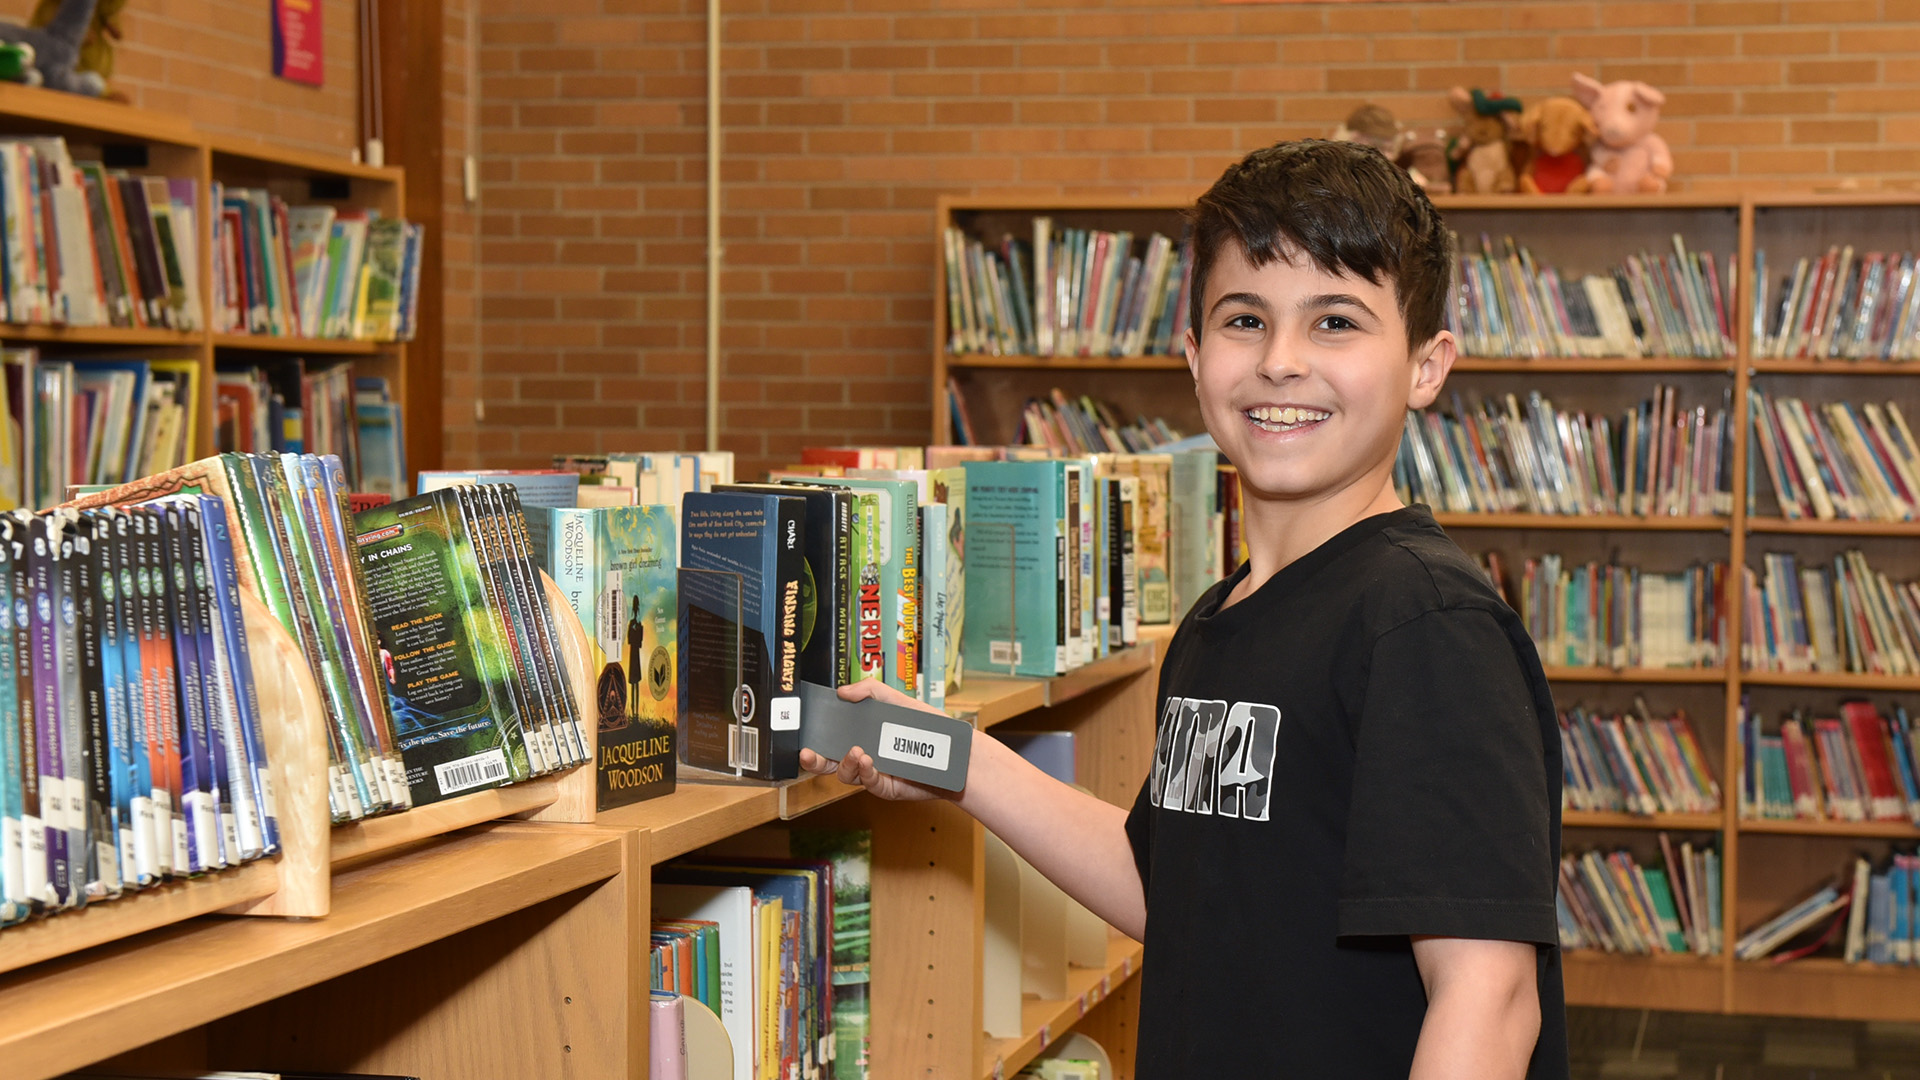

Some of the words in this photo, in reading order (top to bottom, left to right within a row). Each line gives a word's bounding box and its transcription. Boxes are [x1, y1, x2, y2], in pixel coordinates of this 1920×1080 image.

[787, 520, 796, 550] CHARI
[906, 494, 914, 536] EULBERG
[367, 552, 378, 561] IN
[379, 543, 412, 558] CHAINS
[564, 521, 574, 576] WOODSON
[574, 514, 584, 582] JACQUELINE
[839, 536, 847, 580] ATTACK
[906, 547, 914, 566] THE
[902, 568, 917, 600] BEST
[937, 592, 947, 610] Like
[390, 621, 409, 631] READ
[424, 612, 442, 621] BOOK
[513, 568, 528, 613] BEHIND
[526, 616, 540, 658] ENEMY
[541, 592, 560, 651] ETERNITY
[784, 580, 799, 638] FINDING
[860, 584, 882, 672] NERDS
[902, 602, 916, 645] WORST
[932, 610, 945, 638] Magic
[393, 649, 420, 661] FOLLOW
[422, 645, 434, 653] THE
[436, 640, 456, 649] GUIDE
[838, 608, 847, 654] MUTANT
[519, 632, 537, 690] WONDERS
[543, 635, 557, 679] EMPIRE
[781, 640, 797, 692] MIGHTY
[905, 646, 913, 691] SUMMER
[407, 679, 424, 688] PLAY
[439, 670, 458, 679] GAME
[407, 737, 420, 746] the
[420, 733, 437, 744] past.
[437, 728, 455, 738] Save
[454, 724, 467, 733] the
[467, 718, 491, 730] future.
[600, 735, 670, 770] JACQUELINE
[893, 736, 934, 758] CONNER
[608, 763, 664, 791] WOODSON
